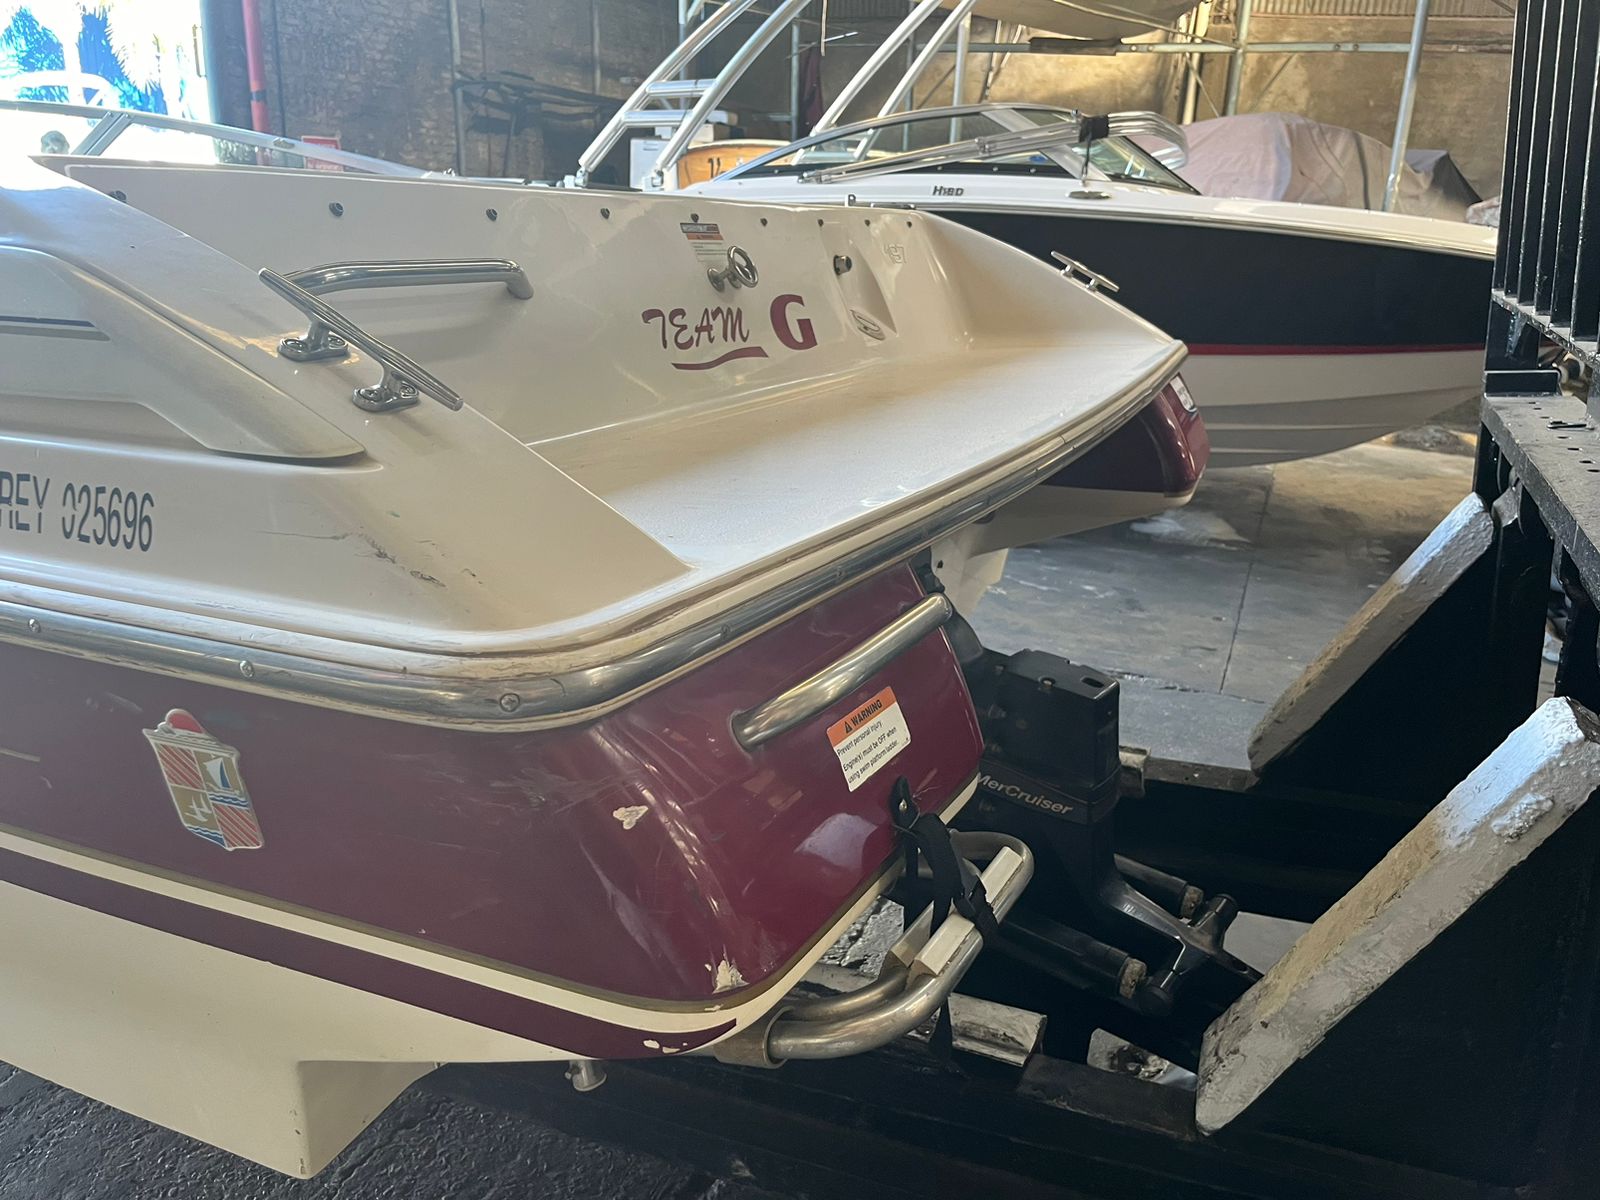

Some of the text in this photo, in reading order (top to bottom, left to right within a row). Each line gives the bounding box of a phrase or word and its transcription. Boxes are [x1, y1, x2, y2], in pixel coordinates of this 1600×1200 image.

[641, 294, 818, 350] TEAM G
[0, 471, 154, 552] REY 025696
[850, 699, 883, 726] WARNING
[837, 741, 854, 756] Prevent
[853, 727, 871, 746] personal
[843, 752, 864, 772] Engine(s)
[862, 745, 873, 757] must
[877, 733, 887, 745] OFF
[886, 727, 897, 738] when
[848, 771, 861, 784] using
[860, 763, 871, 774] swim
[869, 750, 887, 767] platform
[978, 773, 1073, 814] MerCruiser
